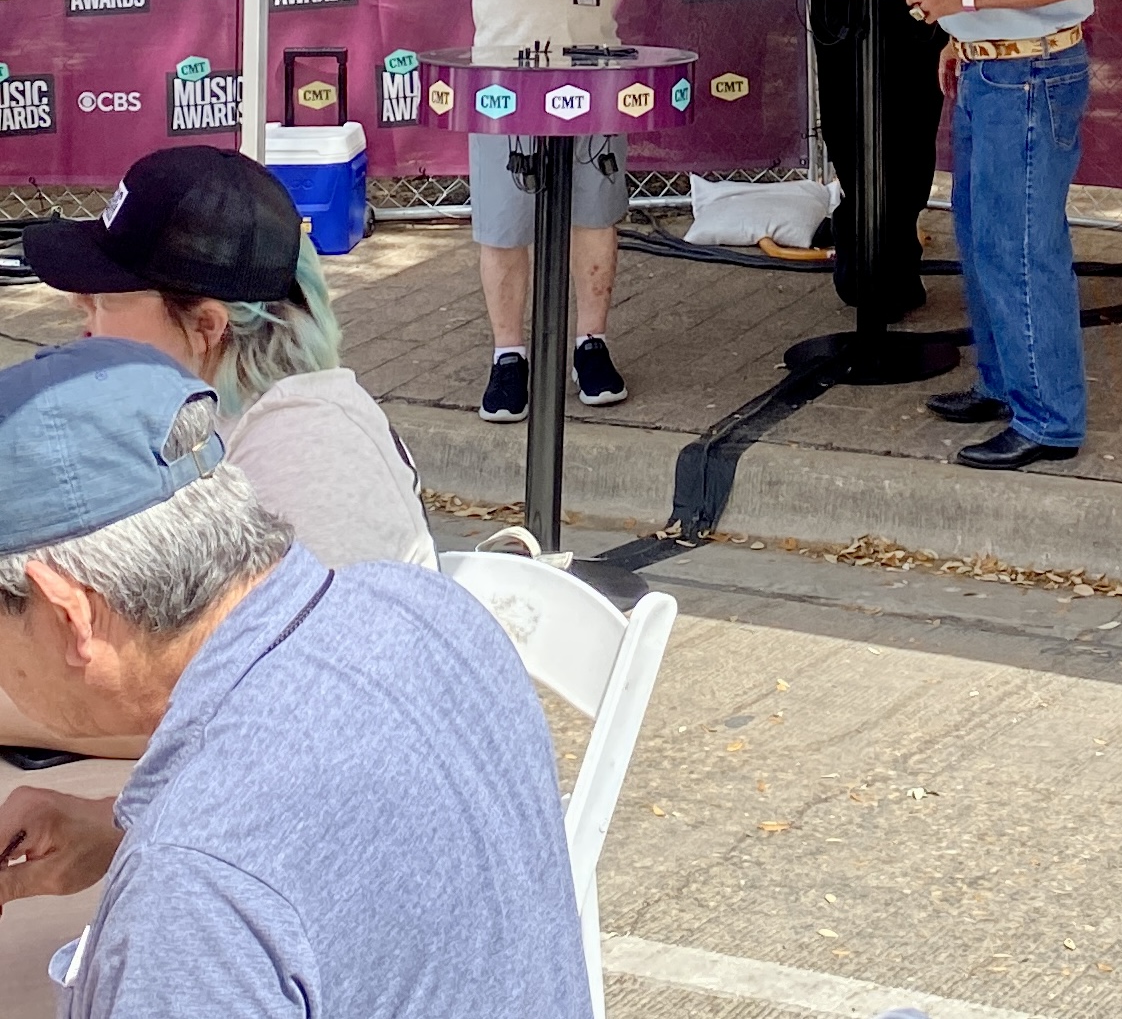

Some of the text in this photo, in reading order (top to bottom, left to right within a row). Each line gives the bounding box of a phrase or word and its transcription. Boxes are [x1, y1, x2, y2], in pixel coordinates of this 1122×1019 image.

[180, 62, 206, 75] CMT
[388, 56, 414, 68] CMT
[0, 80, 48, 108] USIC
[674, 87, 689, 102] CMT
[716, 80, 744, 94] CMT
[96, 91, 141, 112] CBS
[303, 88, 332, 102] CMT
[431, 91, 449, 106] CMT
[480, 94, 511, 110] CMT
[551, 94, 585, 110] CMT
[623, 93, 650, 108] CMT
[0, 103, 52, 131] ARDS
